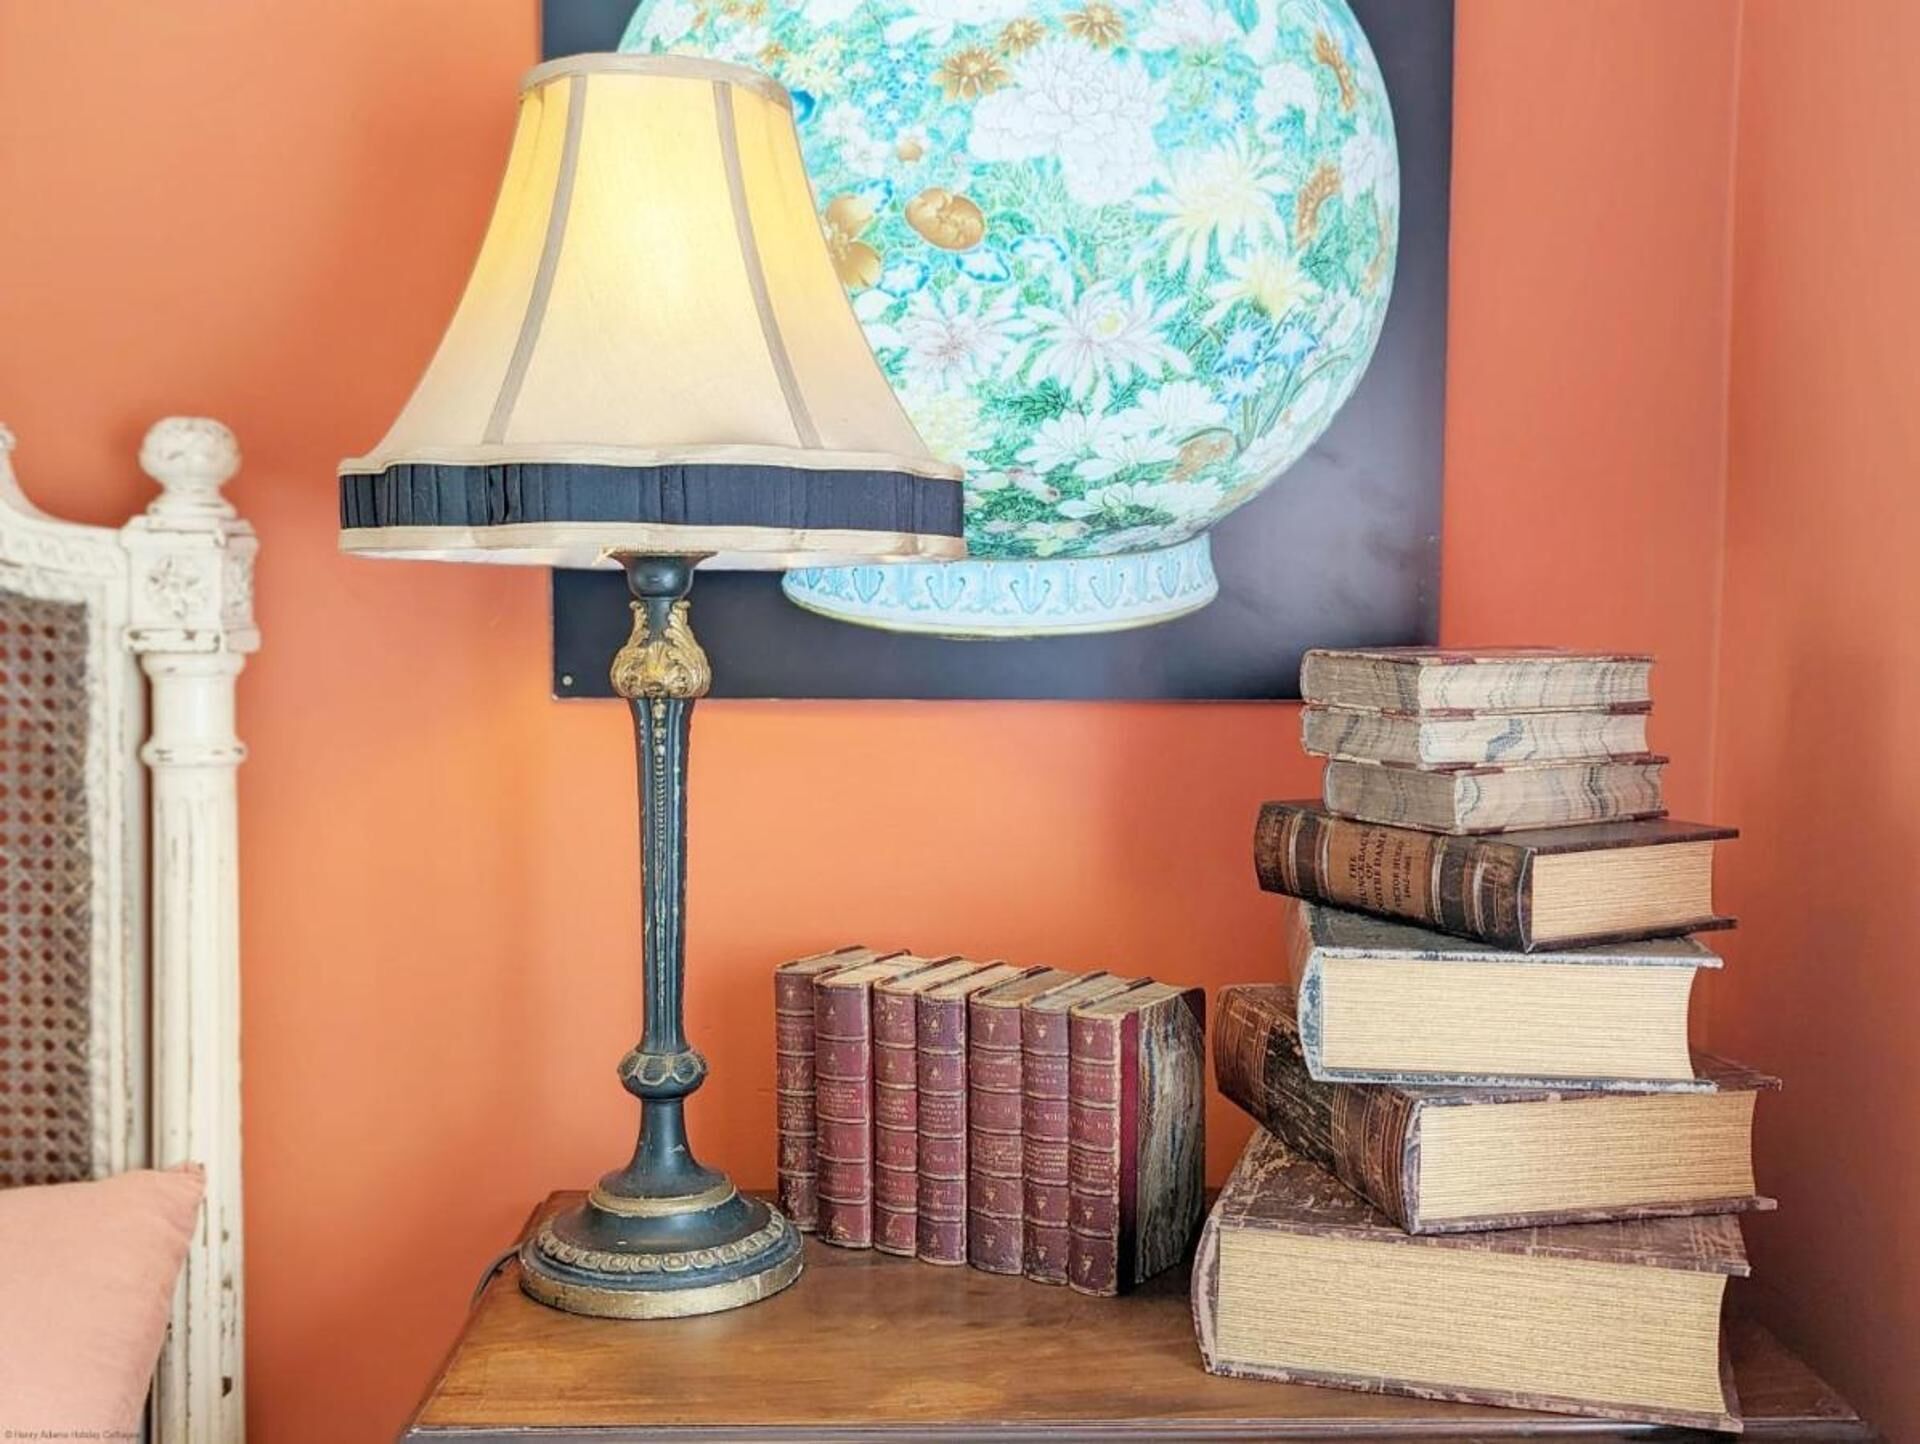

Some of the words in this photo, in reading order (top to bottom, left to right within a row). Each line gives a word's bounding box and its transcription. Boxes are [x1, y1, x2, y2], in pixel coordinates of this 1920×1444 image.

[1374, 832, 1387, 867] DAME
[1393, 841, 1404, 869] HUGO
[1349, 857, 1357, 879] THE
